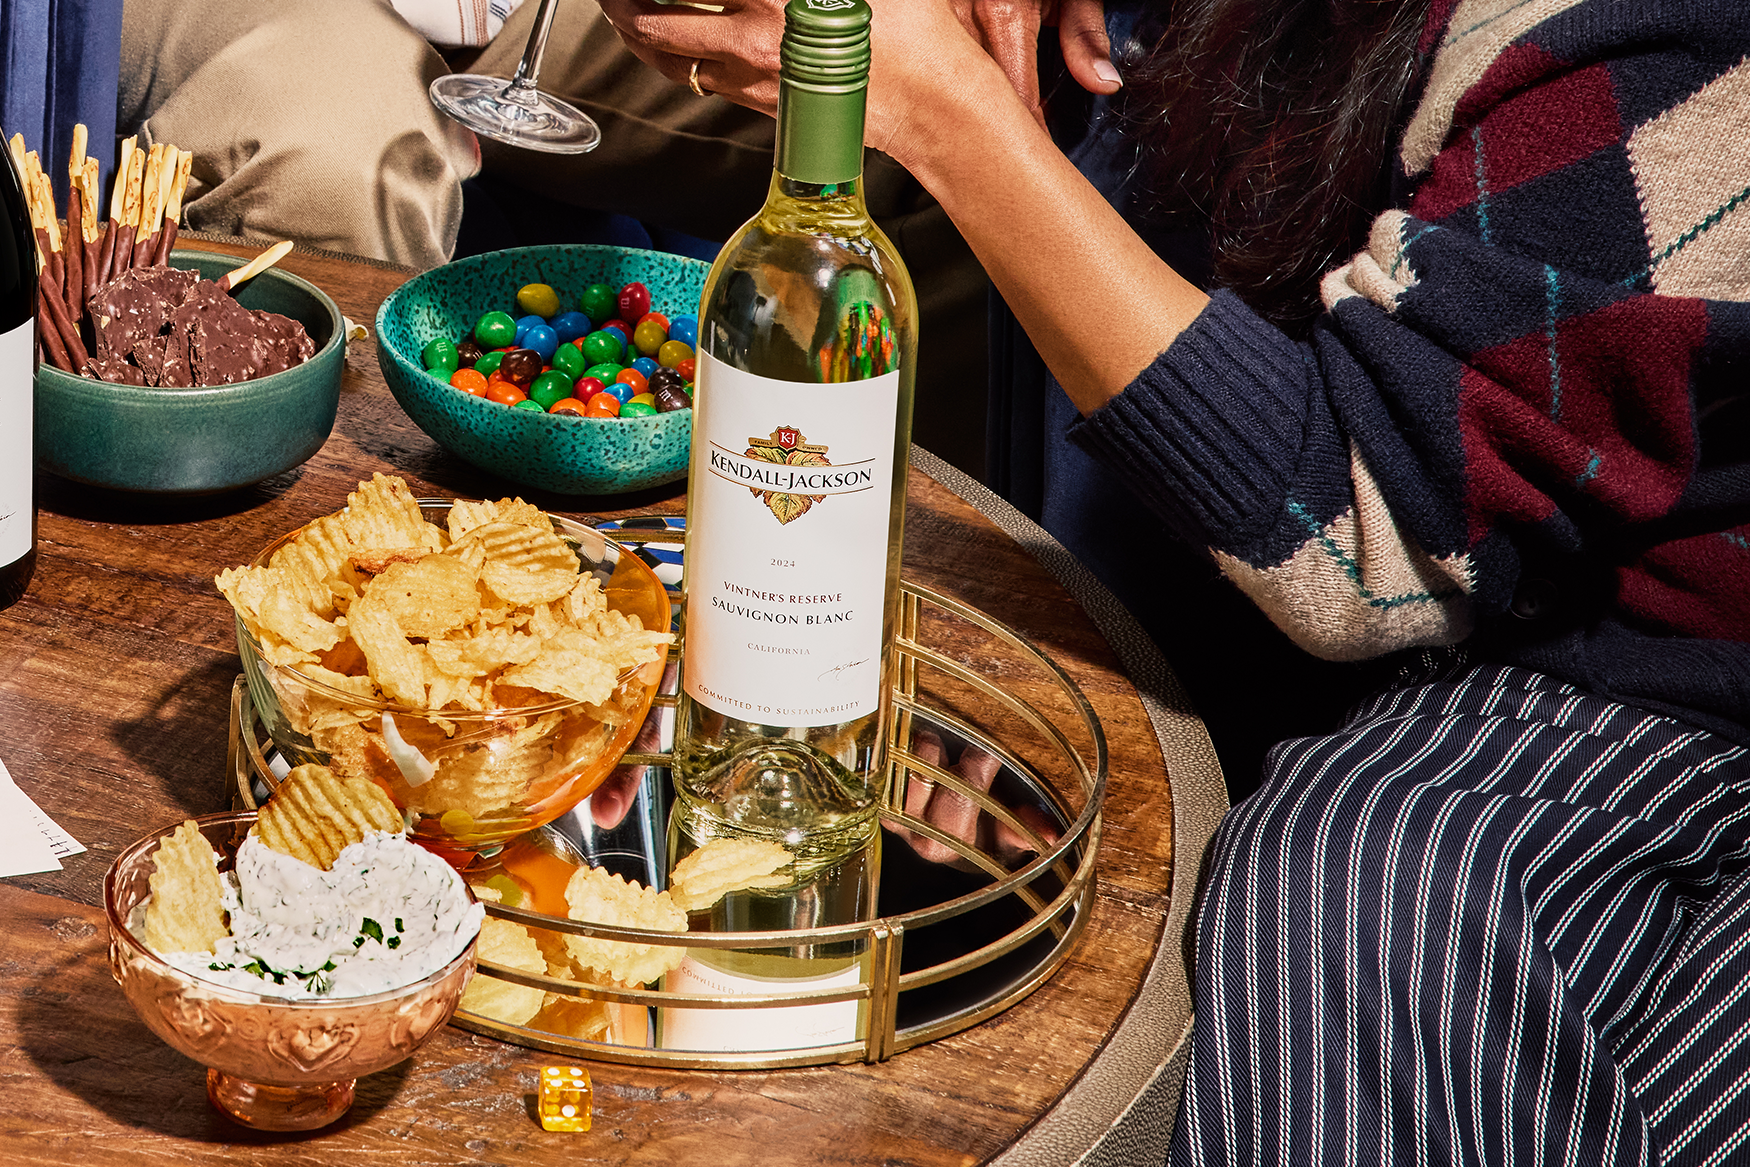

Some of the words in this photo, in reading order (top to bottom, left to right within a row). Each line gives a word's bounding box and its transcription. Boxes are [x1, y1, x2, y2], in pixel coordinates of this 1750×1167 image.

[780, 431, 796, 445] K-J
[710, 449, 872, 490] KENDALL-JACKSON
[770, 558, 796, 568] 2024
[723, 580, 785, 604] VINTNER'S
[789, 592, 842, 604] RESERVE
[711, 596, 799, 625] SAUVIGNON
[805, 610, 854, 625] BLANC
[747, 642, 811, 656] CALIFORNIA
[697, 684, 752, 710] COMMITTED
[757, 705, 771, 713] TO
[776, 700, 860, 716] SUSTAINABILITY
